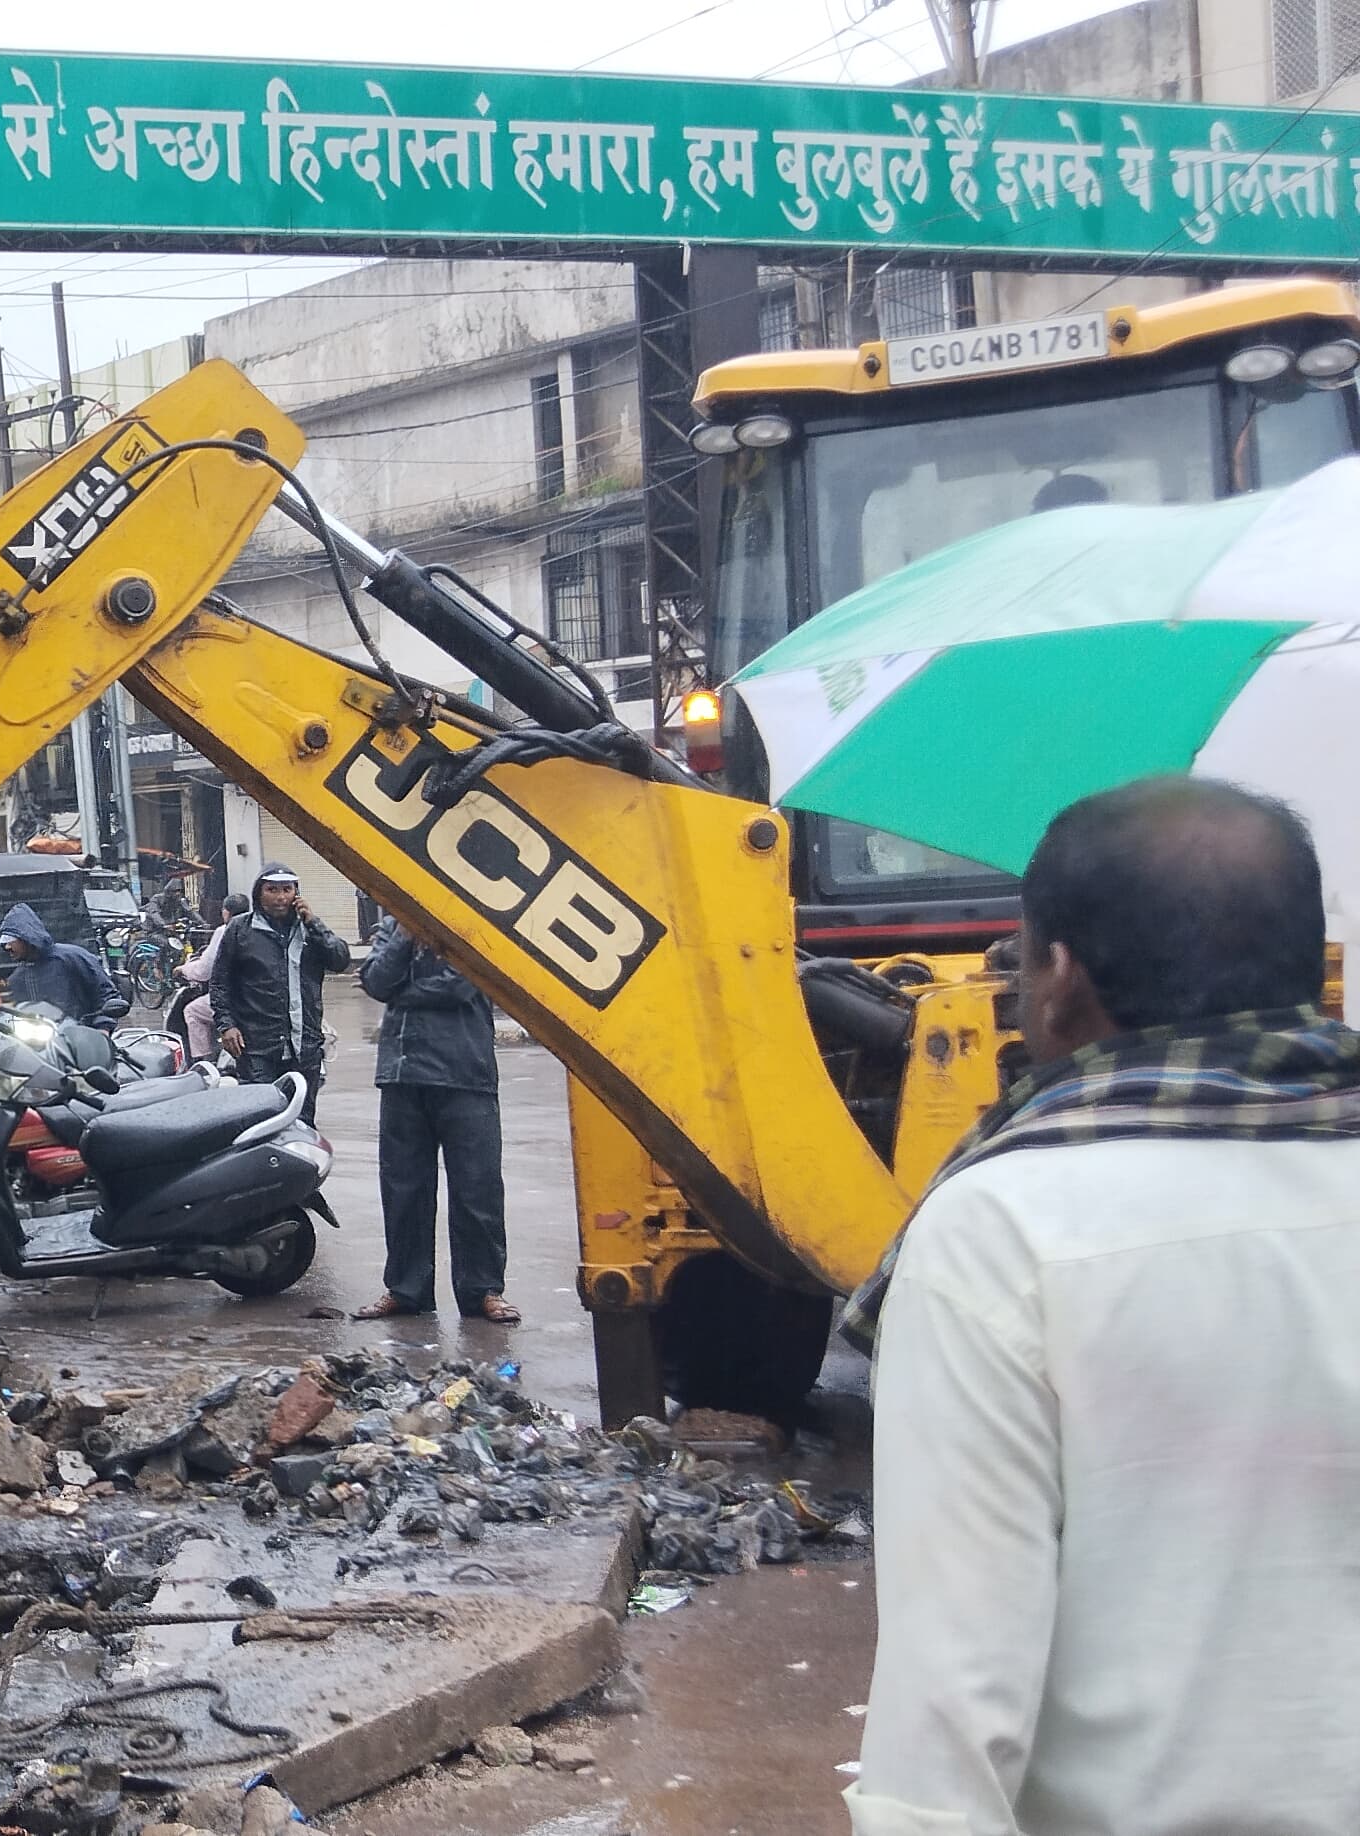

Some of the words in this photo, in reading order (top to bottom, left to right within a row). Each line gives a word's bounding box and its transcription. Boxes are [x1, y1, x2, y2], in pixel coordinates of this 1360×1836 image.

[1, 67, 56, 180] से
[84, 104, 245, 185] अच्छा
[683, 126, 758, 213] हम
[773, 103, 930, 234] बुलबुलें
[935, 104, 983, 222] हैं
[992, 110, 1103, 223] इसके
[1116, 115, 1154, 213] ये
[345, 753, 645, 991] JCB
